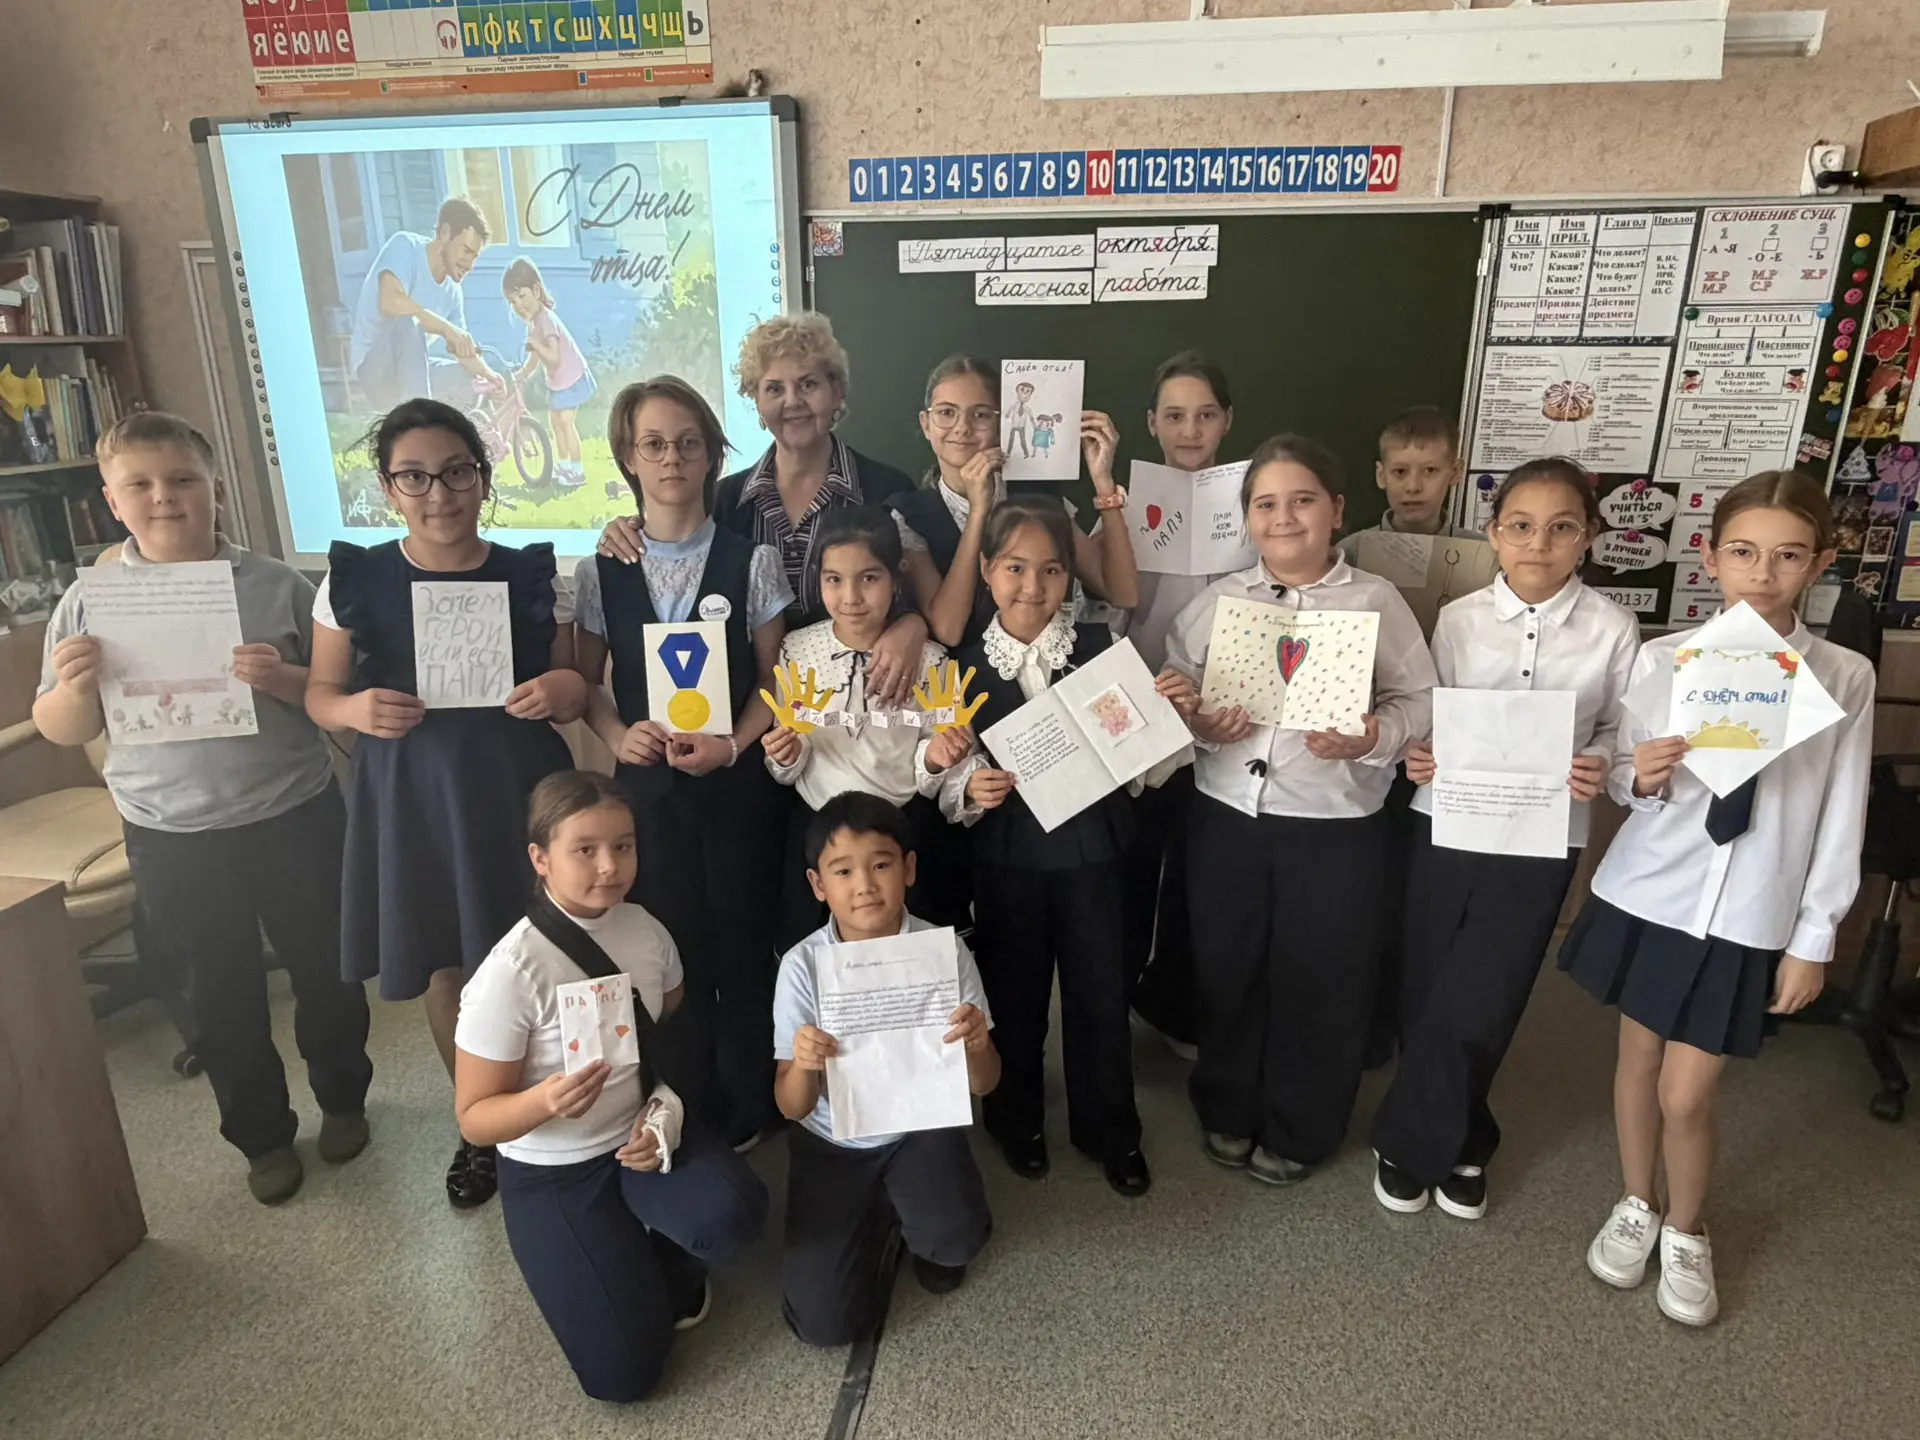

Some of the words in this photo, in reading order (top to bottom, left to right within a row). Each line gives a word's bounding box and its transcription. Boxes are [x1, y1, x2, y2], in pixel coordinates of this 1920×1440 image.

[854, 166, 868, 195] 0
[878, 166, 888, 195] 1
[900, 165, 913, 194] 2
[923, 164, 936, 193] 3
[946, 163, 960, 192] 4
[971, 162, 984, 192] 5
[994, 161, 1008, 191] 6
[1019, 161, 1032, 190] 7
[1042, 160, 1056, 189] 8
[1066, 159, 1080, 189] 9
[1089, 158, 1110, 188] 10
[1117, 157, 1137, 187] 11
[1145, 156, 1167, 187] 12
[1173, 156, 1195, 187] 13
[1201, 156, 1224, 187] 14
[1229, 155, 1252, 186] 15
[1257, 154, 1281, 186] 16
[1286, 154, 1309, 186] 17
[1314, 154, 1338, 185] 18
[1343, 154, 1367, 185] 19
[1369, 153, 1397, 185] 20
[526, 163, 580, 236] С
[580, 163, 695, 229] Днем
[1711, 210, 1798, 222] СКЛОНЕНИЕ
[1801, 208, 1837, 221] СУЩ.
[1514, 219, 1540, 230] Имя
[1560, 218, 1585, 229] Имя
[1604, 217, 1647, 228] Глагол
[1768, 224, 1779, 235] 2
[1818, 223, 1828, 235] 3
[1507, 234, 1543, 245] СУЩ.
[1551, 233, 1590, 243] ПРИЛ.
[1511, 250, 1535, 260] Кто?
[1550, 249, 1587, 259] Какой?
[1613, 248, 1646, 256] делает?
[590, 230, 690, 287] отца!
[1611, 260, 1645, 268] сделал?
[1510, 262, 1533, 272] Что?
[1548, 261, 1585, 271] Какая?
[1547, 274, 1583, 283] Какие?
[1597, 272, 1612, 280] Что
[1614, 272, 1637, 282] будет
[978, 275, 1090, 298] Классная
[1545, 286, 1580, 296] Какое?
[1597, 284, 1632, 293] делать?
[1496, 300, 1536, 309] Предмет
[1540, 299, 1582, 309] Признак
[1589, 298, 1635, 308] Действие
[1537, 311, 1580, 322] предмета
[1588, 311, 1633, 321] предмета
[1707, 314, 1740, 325] Время
[1742, 313, 1801, 324] ГЛАГОЛА
[1757, 340, 1811, 350] Настоящее
[1621, 491, 1652, 502] БУДУ
[1690, 493, 1703, 508] 5
[1610, 502, 1662, 513] УЧИТЬСЯ
[1618, 514, 1634, 524] НА
[1153, 511, 1183, 551] ПАПУ
[1689, 533, 1703, 547] 8
[1612, 544, 1652, 557] ЛУЧШЕЙ
[1687, 572, 1699, 585] 2
[1687, 605, 1698, 618] 5
